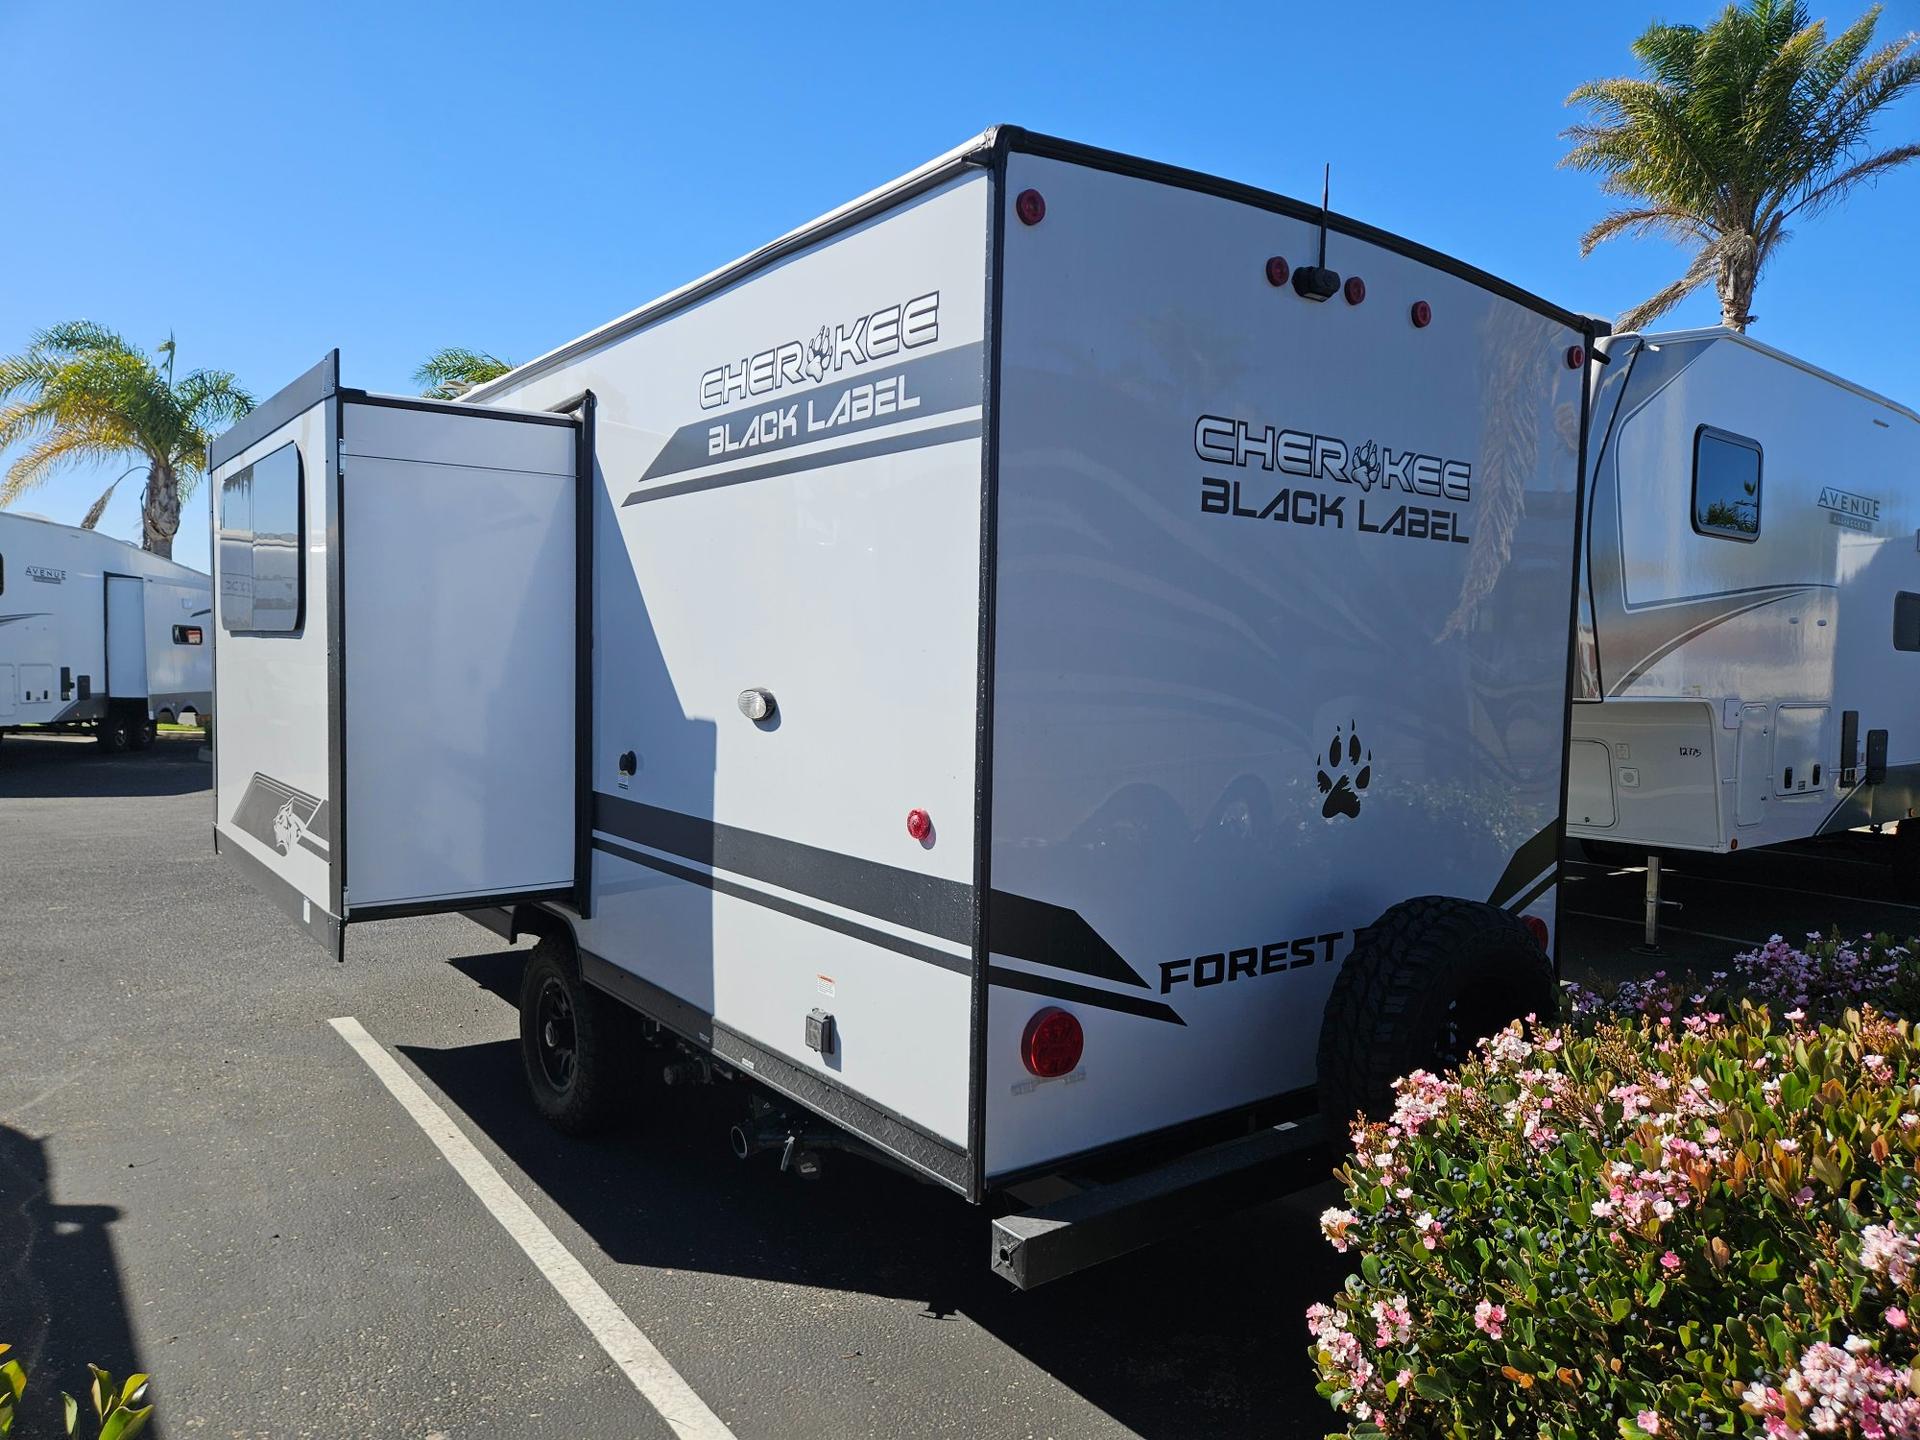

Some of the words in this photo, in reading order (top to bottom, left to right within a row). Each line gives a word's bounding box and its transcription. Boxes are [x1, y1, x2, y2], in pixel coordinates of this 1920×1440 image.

[708, 403, 799, 457] BLACK
[807, 374, 921, 433] LABEL
[1201, 476, 1346, 529] BLACK
[1358, 499, 1470, 544] LABEL
[1817, 487, 1881, 519] AVENUE
[25, 565, 67, 581] AVENUE
[1158, 931, 1344, 995] FOREST
